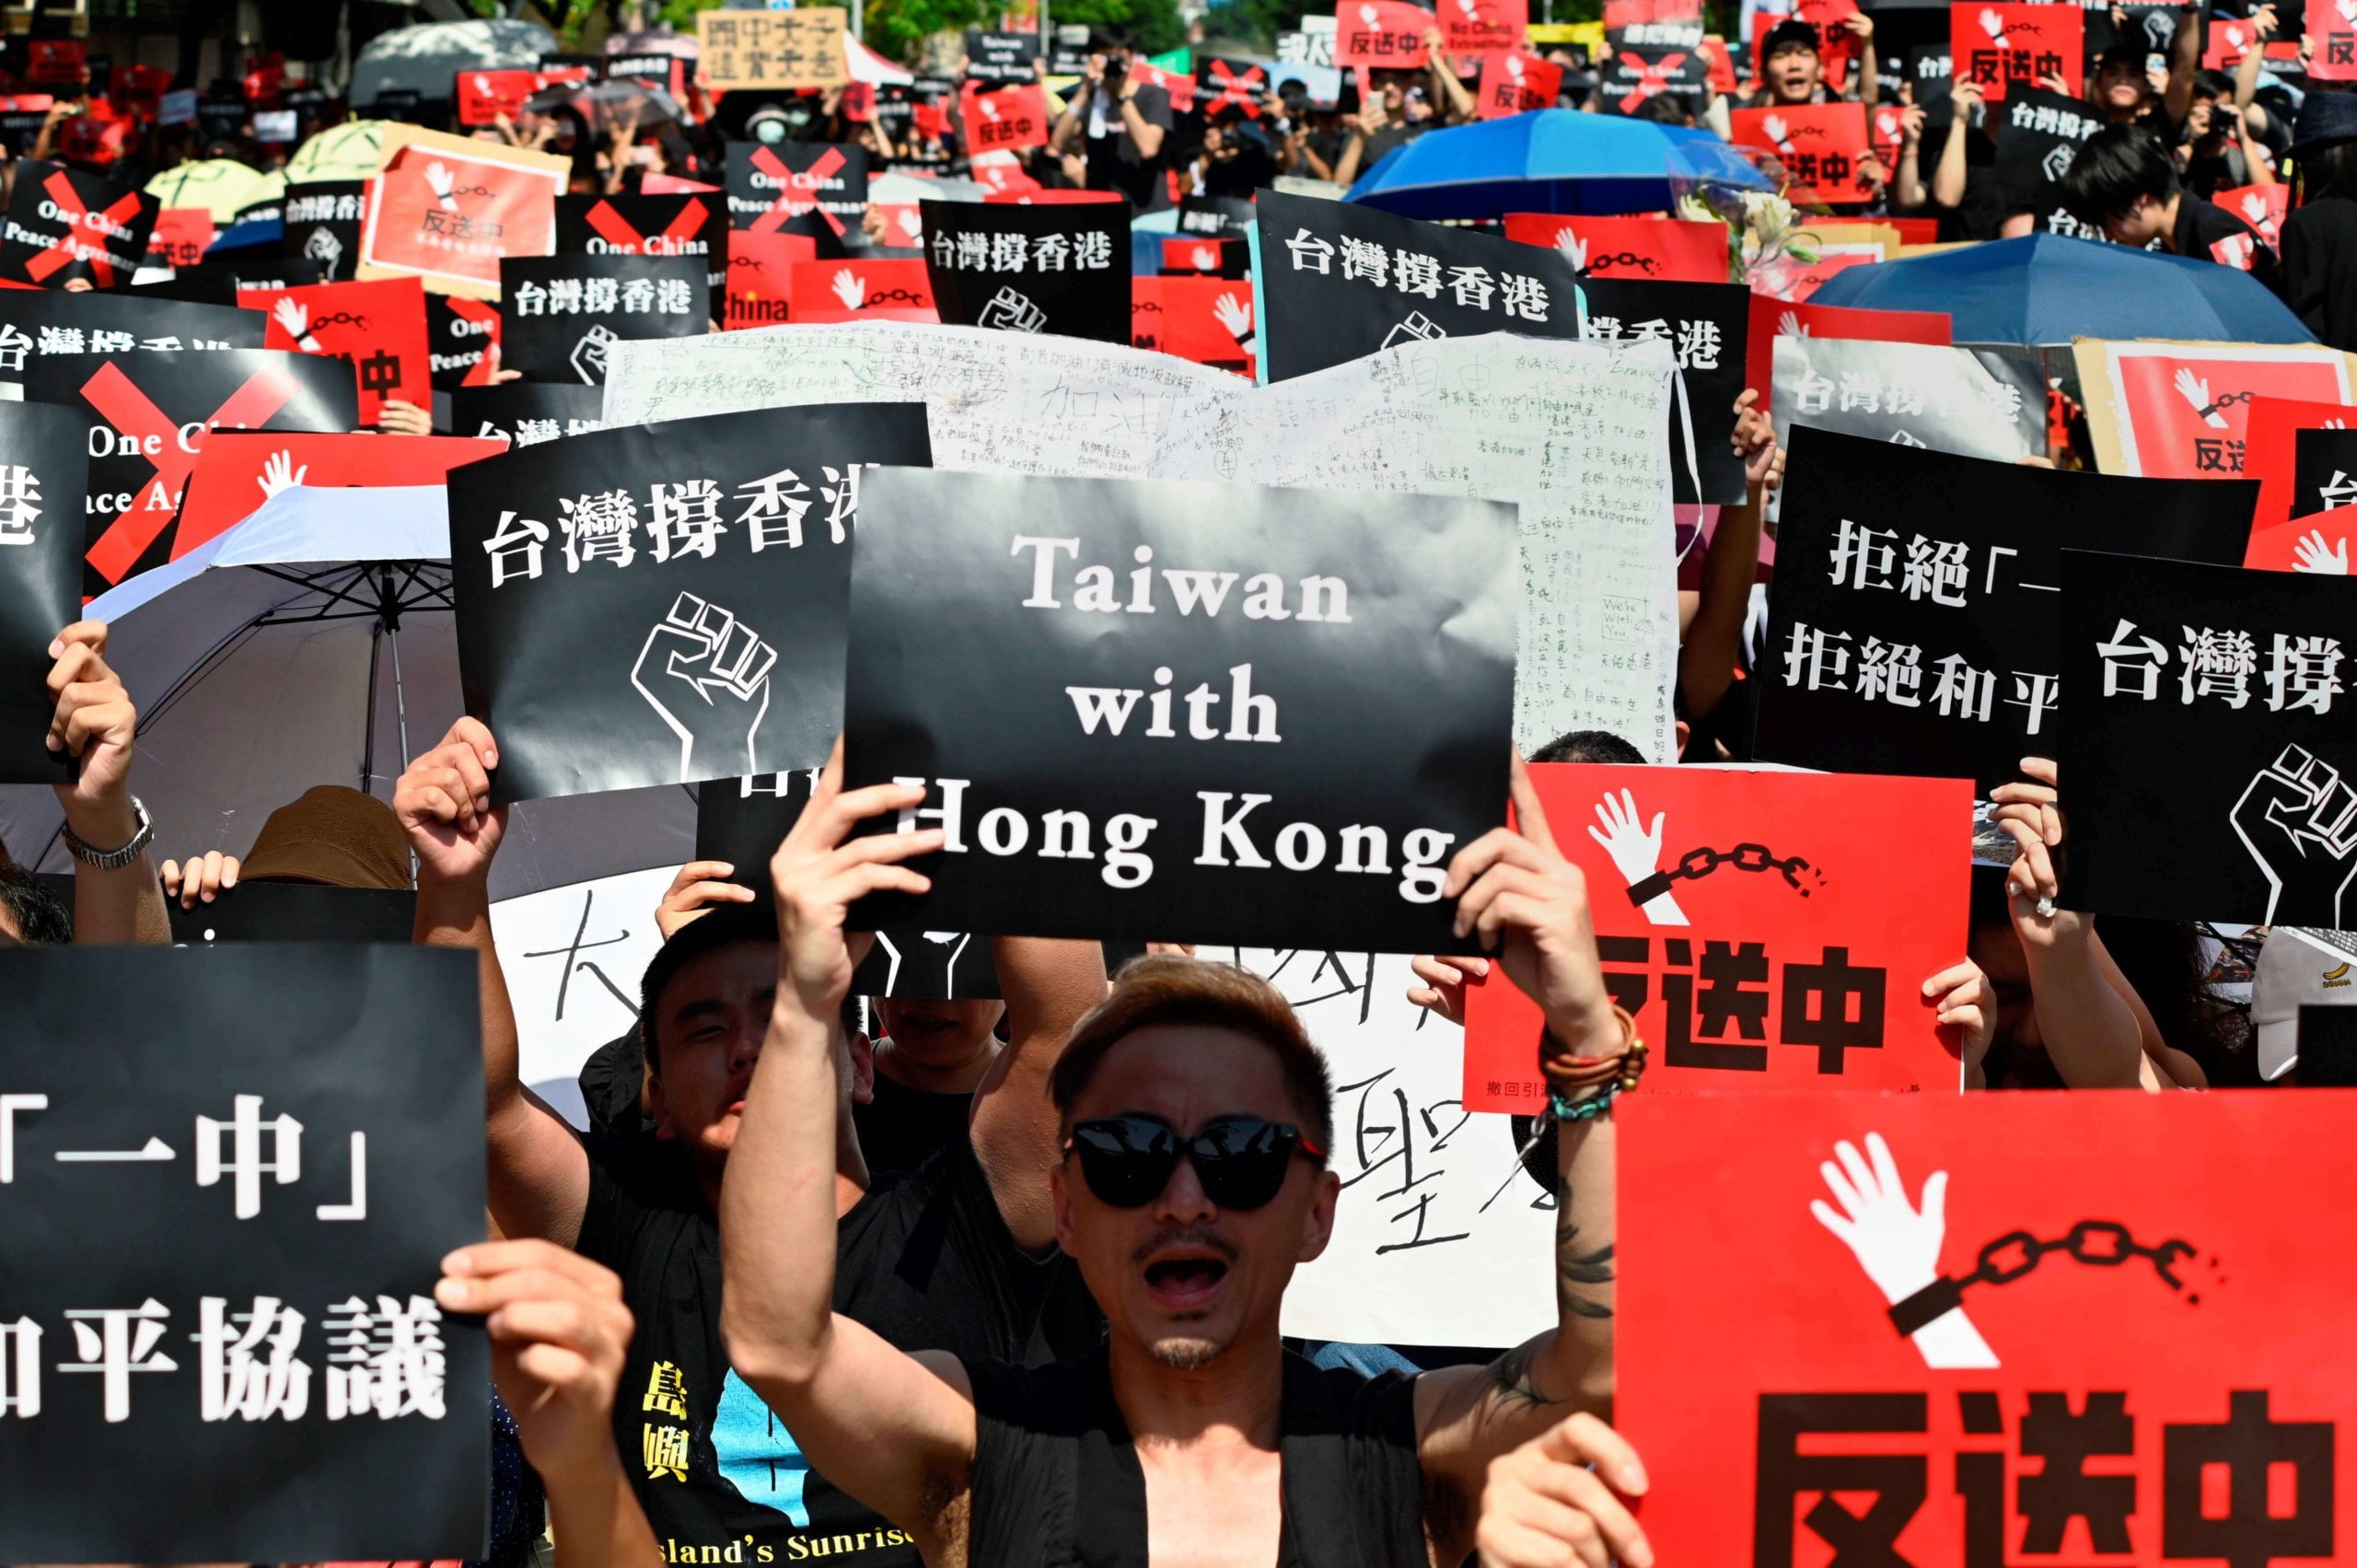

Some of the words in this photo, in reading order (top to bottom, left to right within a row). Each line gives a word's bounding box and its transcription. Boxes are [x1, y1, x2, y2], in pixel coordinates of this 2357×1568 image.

[1350, 32, 1419, 55] 反送中
[1970, 49, 2063, 85] 反送中
[749, 170, 787, 190] One
[791, 169, 846, 191] China
[37, 200, 81, 226] One
[727, 195, 780, 215] Peace
[422, 208, 505, 240] 反送中
[586, 236, 636, 256] One
[644, 235, 710, 256] China
[931, 227, 1112, 273] 台灣撐香港
[1284, 226, 1550, 323] 台灣撐香港
[515, 277, 692, 317] 台灣撐香港
[722, 289, 790, 321] hina
[449, 318, 495, 339] One
[429, 350, 484, 373] Peace
[89, 425, 162, 458] One
[1010, 534, 1353, 624] Taiwan
[1782, 621, 2060, 735] 拒絕和平
[1065, 663, 1283, 744] with
[892, 776, 1158, 889] Hong
[1193, 791, 1456, 904] Kong
[0, 1094, 366, 1221] 「一中」
[642, 1360, 689, 1483] 島嶼
[1754, 1389, 2336, 1568] 反送中
[657, 1534, 774, 1565] sland's
